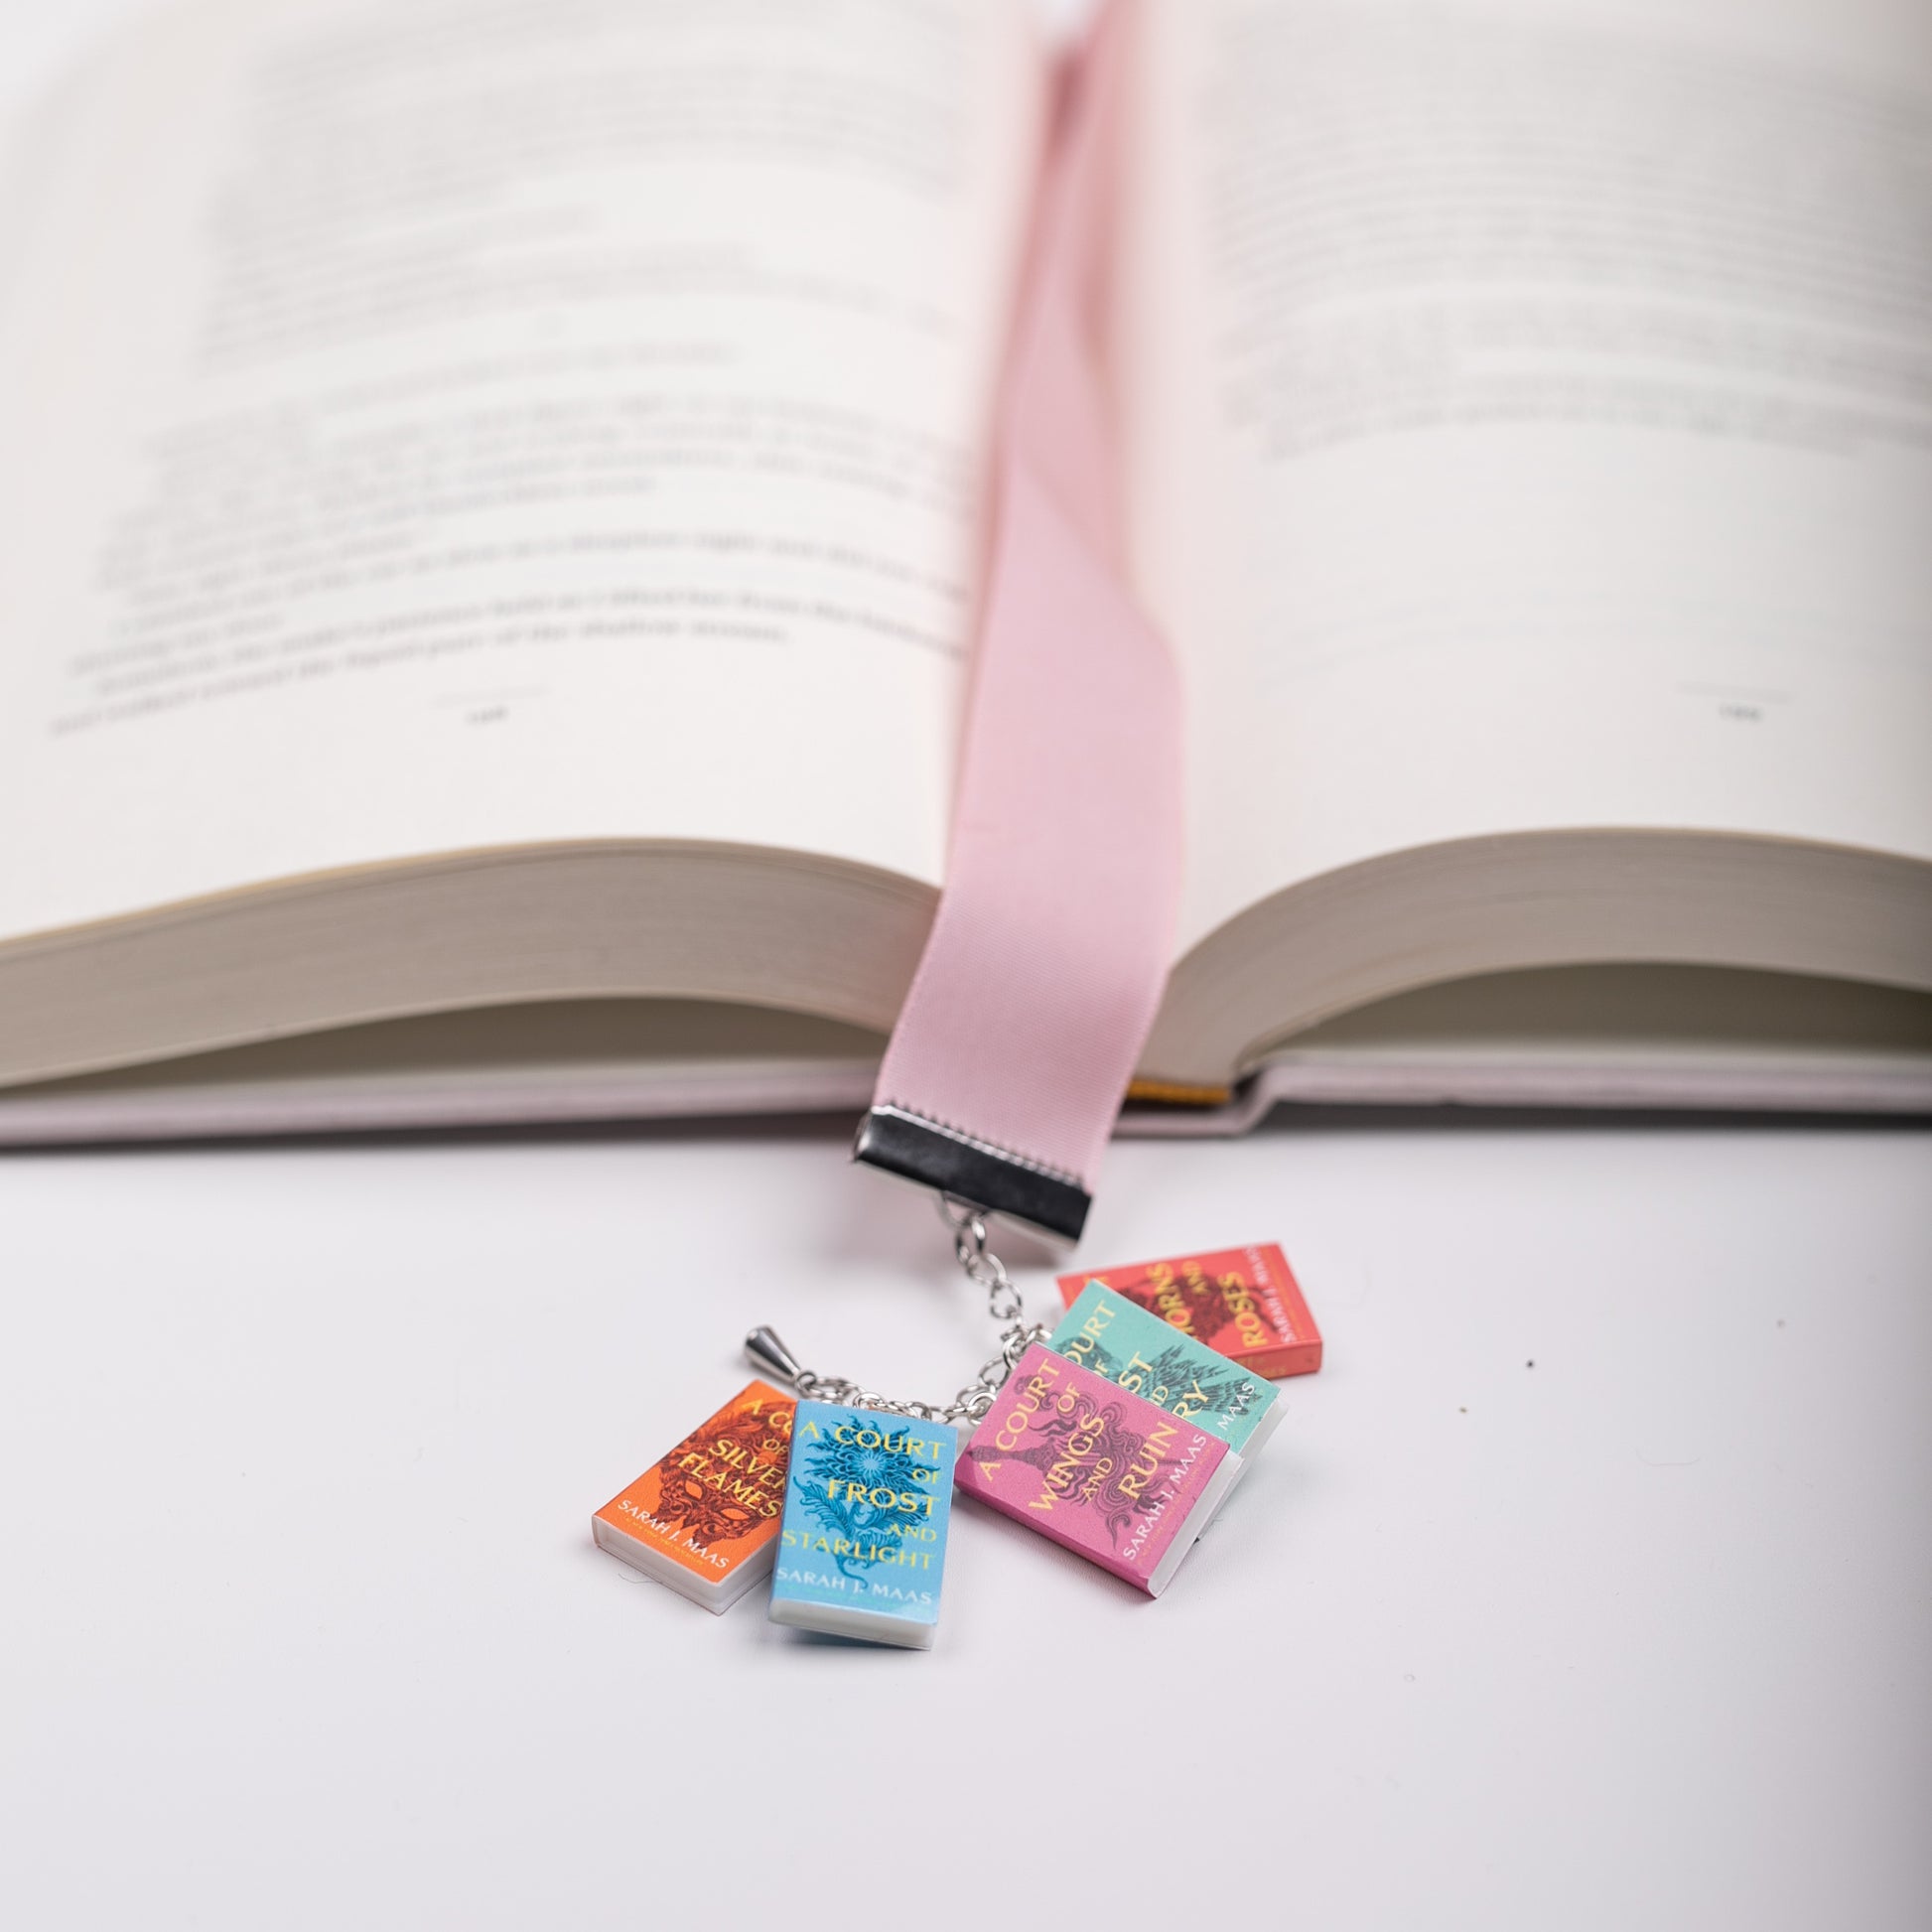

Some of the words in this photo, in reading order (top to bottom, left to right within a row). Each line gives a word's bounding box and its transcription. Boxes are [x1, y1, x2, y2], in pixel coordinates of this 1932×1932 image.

[1216, 1271, 1268, 1348] ROSES
[1062, 1300, 1116, 1366] OURT
[1118, 1350, 1154, 1395] ST
[740, 1398, 763, 1416] A
[978, 1460, 1002, 1482] A
[995, 1358, 1060, 1451] COURT
[1056, 1382, 1081, 1413] OF
[1172, 1379, 1210, 1421] RY
[1217, 1381, 1256, 1432] MAAS
[763, 1438, 790, 1455] OF
[798, 1421, 820, 1440] A
[835, 1426, 946, 1460] COURT
[1028, 1413, 1105, 1512] WINGS
[1118, 1420, 1179, 1501] RUIN
[678, 1451, 783, 1518] FLAMES
[827, 1479, 940, 1517] FROST
[912, 1468, 939, 1485] OF
[1080, 1456, 1114, 1502] AND
[1123, 1502, 1166, 1561] SARAH
[1169, 1434, 1207, 1486] MAAS
[618, 1499, 671, 1535] SARAH
[683, 1538, 730, 1569] MAAS
[780, 1529, 935, 1571] STARLIGHT
[887, 1523, 937, 1544] AND
[775, 1567, 845, 1589] SARAH
[872, 1584, 933, 1605] MAAS
